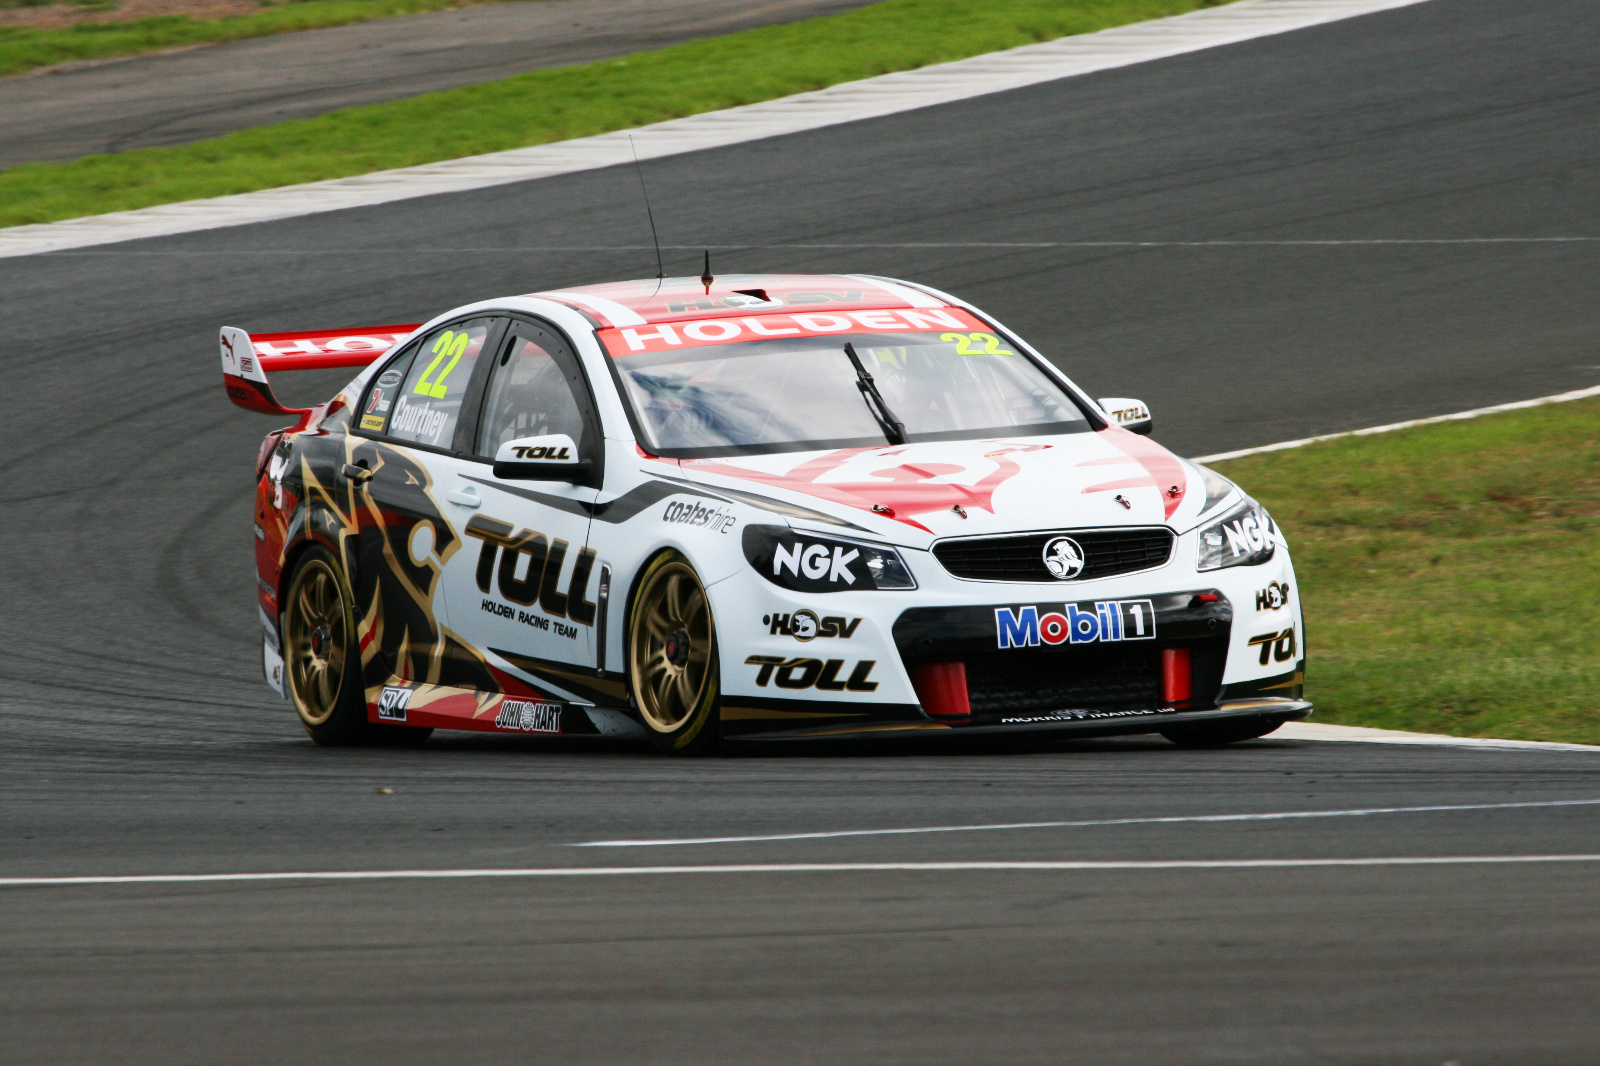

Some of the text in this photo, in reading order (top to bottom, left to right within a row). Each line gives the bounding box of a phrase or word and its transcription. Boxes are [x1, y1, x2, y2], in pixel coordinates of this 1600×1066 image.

[621, 309, 968, 351] HOLDEN
[940, 332, 1014, 356] 22
[413, 330, 470, 400] 22
[391, 395, 449, 446] Courtney
[1111, 406, 1149, 422] TOLL
[511, 446, 571, 460] TOLL
[1222, 514, 1277, 558] NGK
[464, 513, 598, 628] TOLL
[773, 541, 861, 586] NGK
[481, 598, 578, 640] HOLDEN RACING TEAM
[994, 602, 1122, 649] Mobil
[744, 654, 880, 692] TOLL
[495, 700, 562, 732] JOHN HART
[1001, 715, 1072, 723] MORRIS
